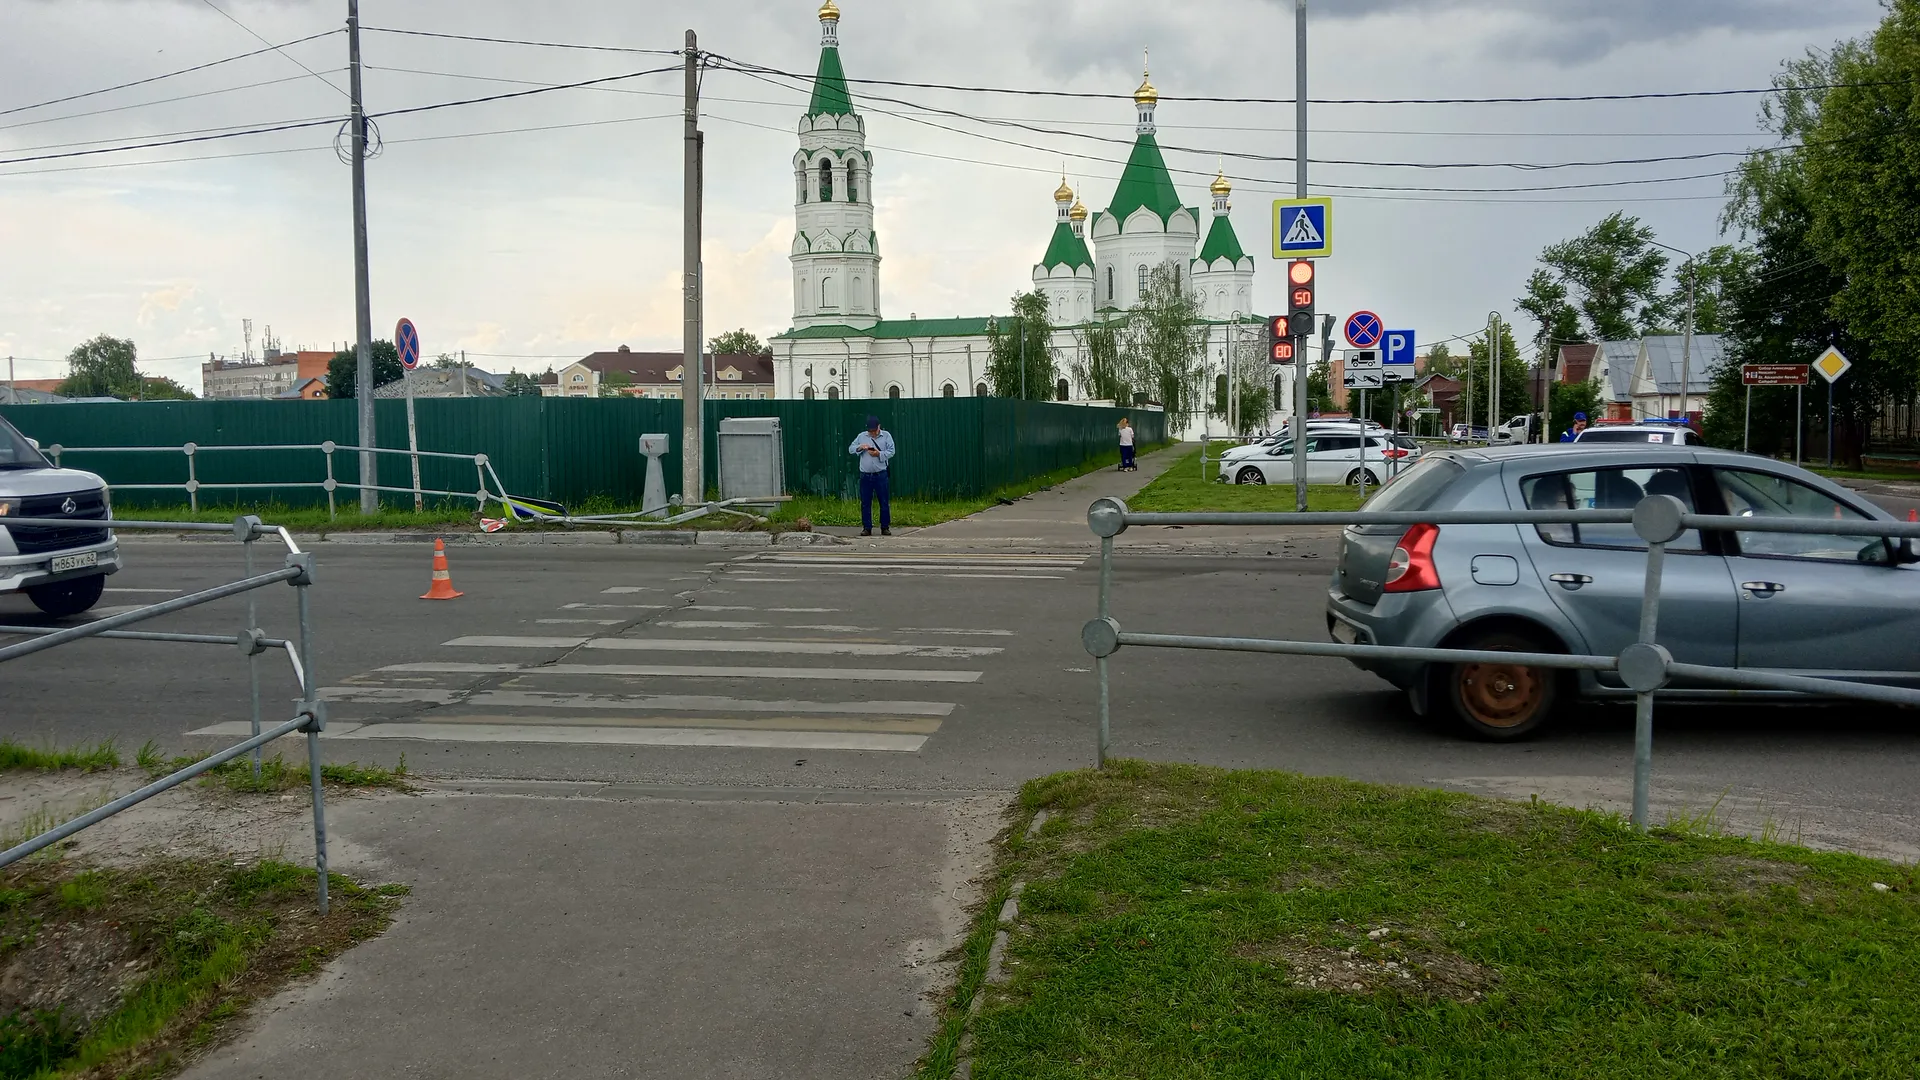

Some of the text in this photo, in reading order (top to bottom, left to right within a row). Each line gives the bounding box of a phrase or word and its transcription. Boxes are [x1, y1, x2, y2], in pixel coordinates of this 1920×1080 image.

[1295, 291, 1311, 305] 50
[1275, 345, 1292, 358] 80
[1388, 334, 1406, 361] P
